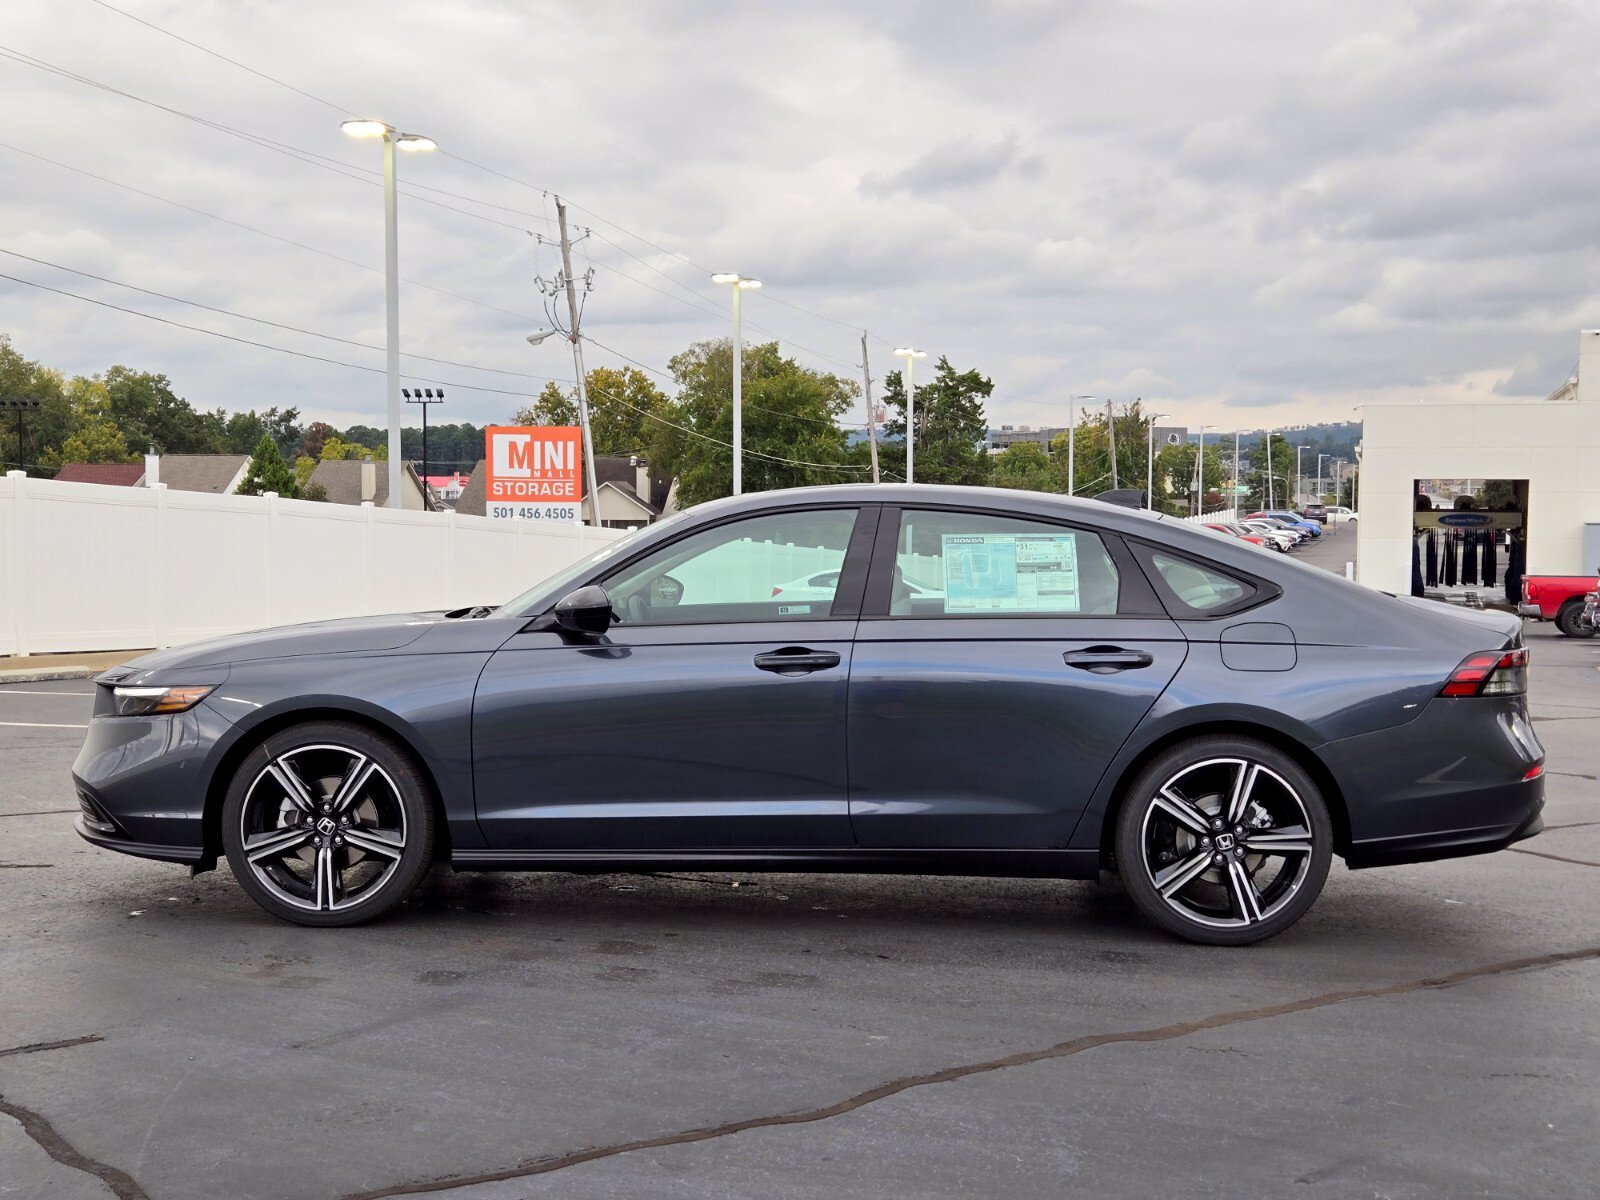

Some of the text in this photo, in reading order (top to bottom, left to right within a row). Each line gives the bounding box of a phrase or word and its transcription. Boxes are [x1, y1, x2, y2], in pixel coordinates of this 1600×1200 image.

[509, 441, 575, 470] MINI
[493, 482, 575, 496] STORAGE
[493, 507, 574, 519] 501456.4505
